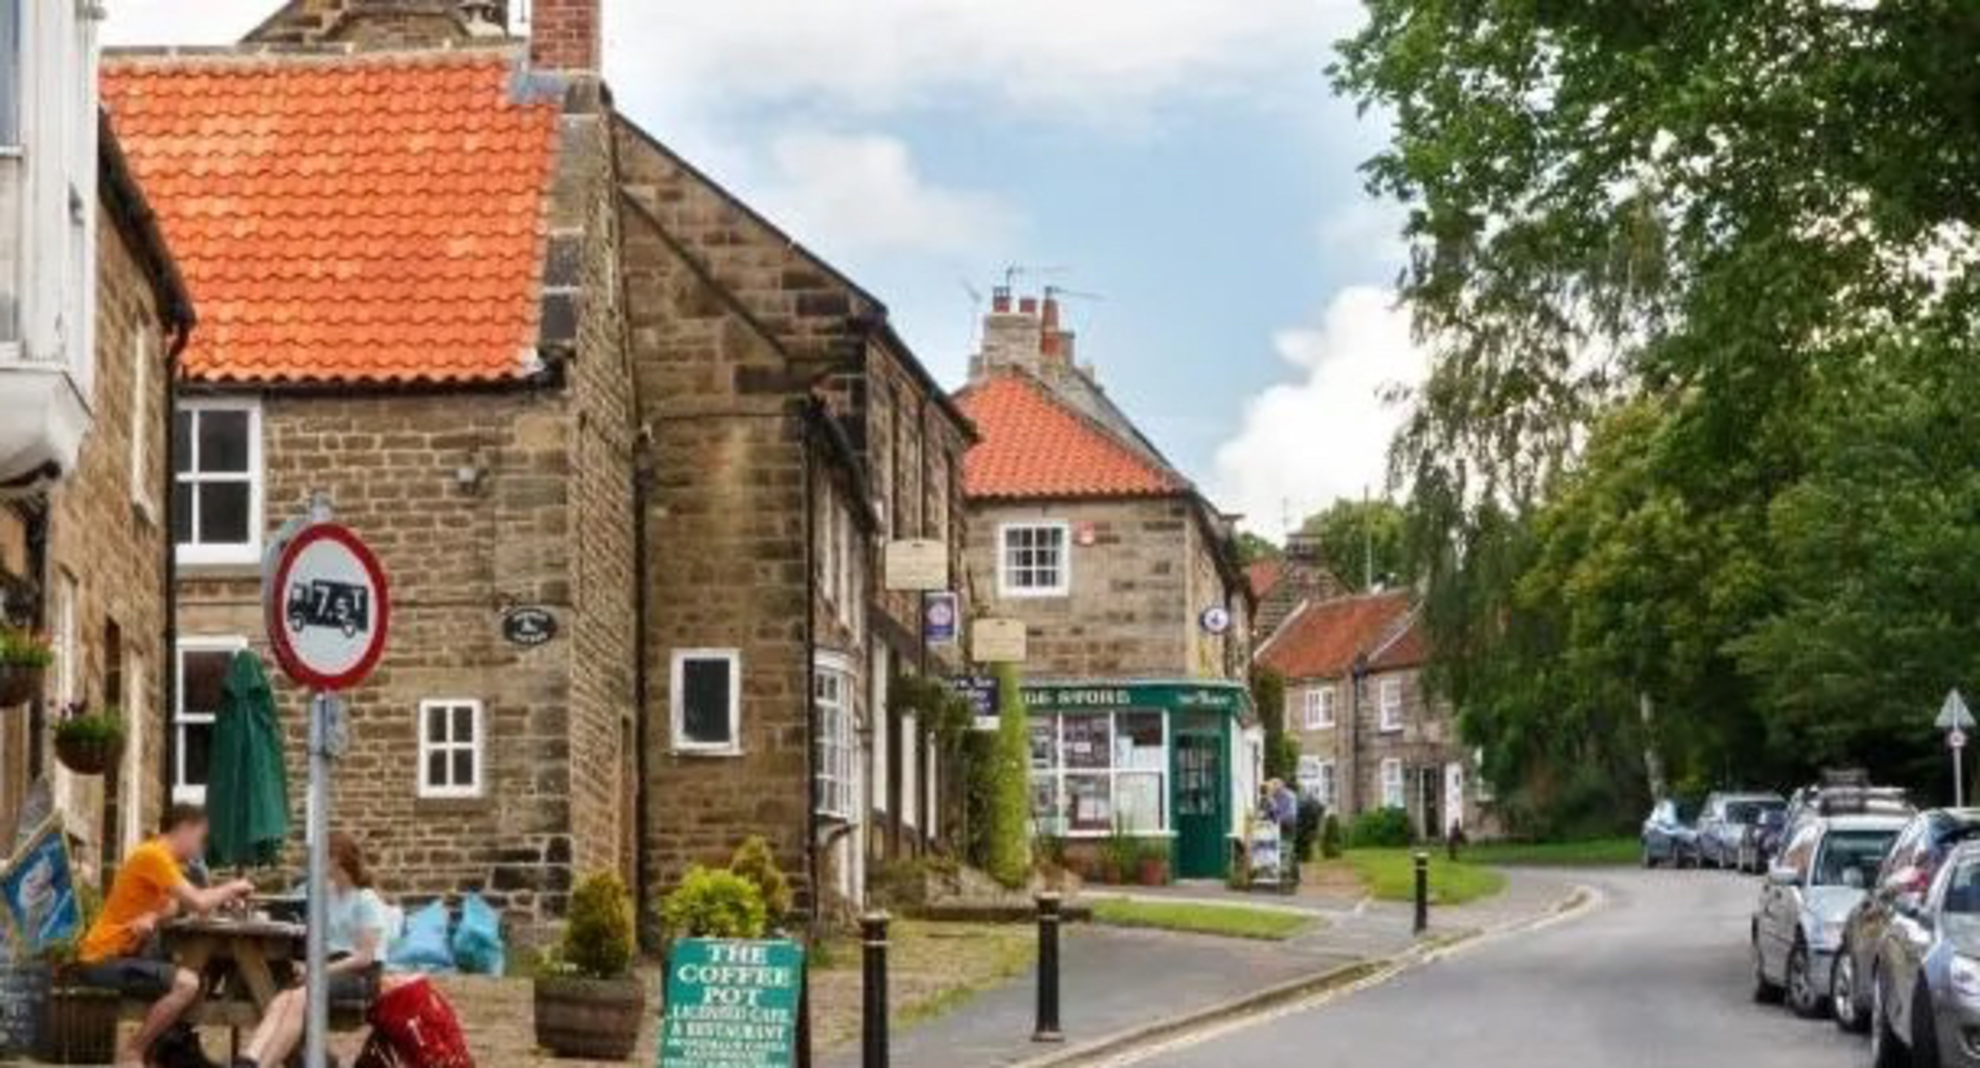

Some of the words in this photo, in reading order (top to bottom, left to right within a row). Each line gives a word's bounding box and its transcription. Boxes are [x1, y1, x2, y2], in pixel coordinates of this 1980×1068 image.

[1058, 690, 1131, 705] STORE
[706, 944, 768, 964] THE
[676, 963, 790, 986] COFFEE
[703, 986, 763, 1006] POT
